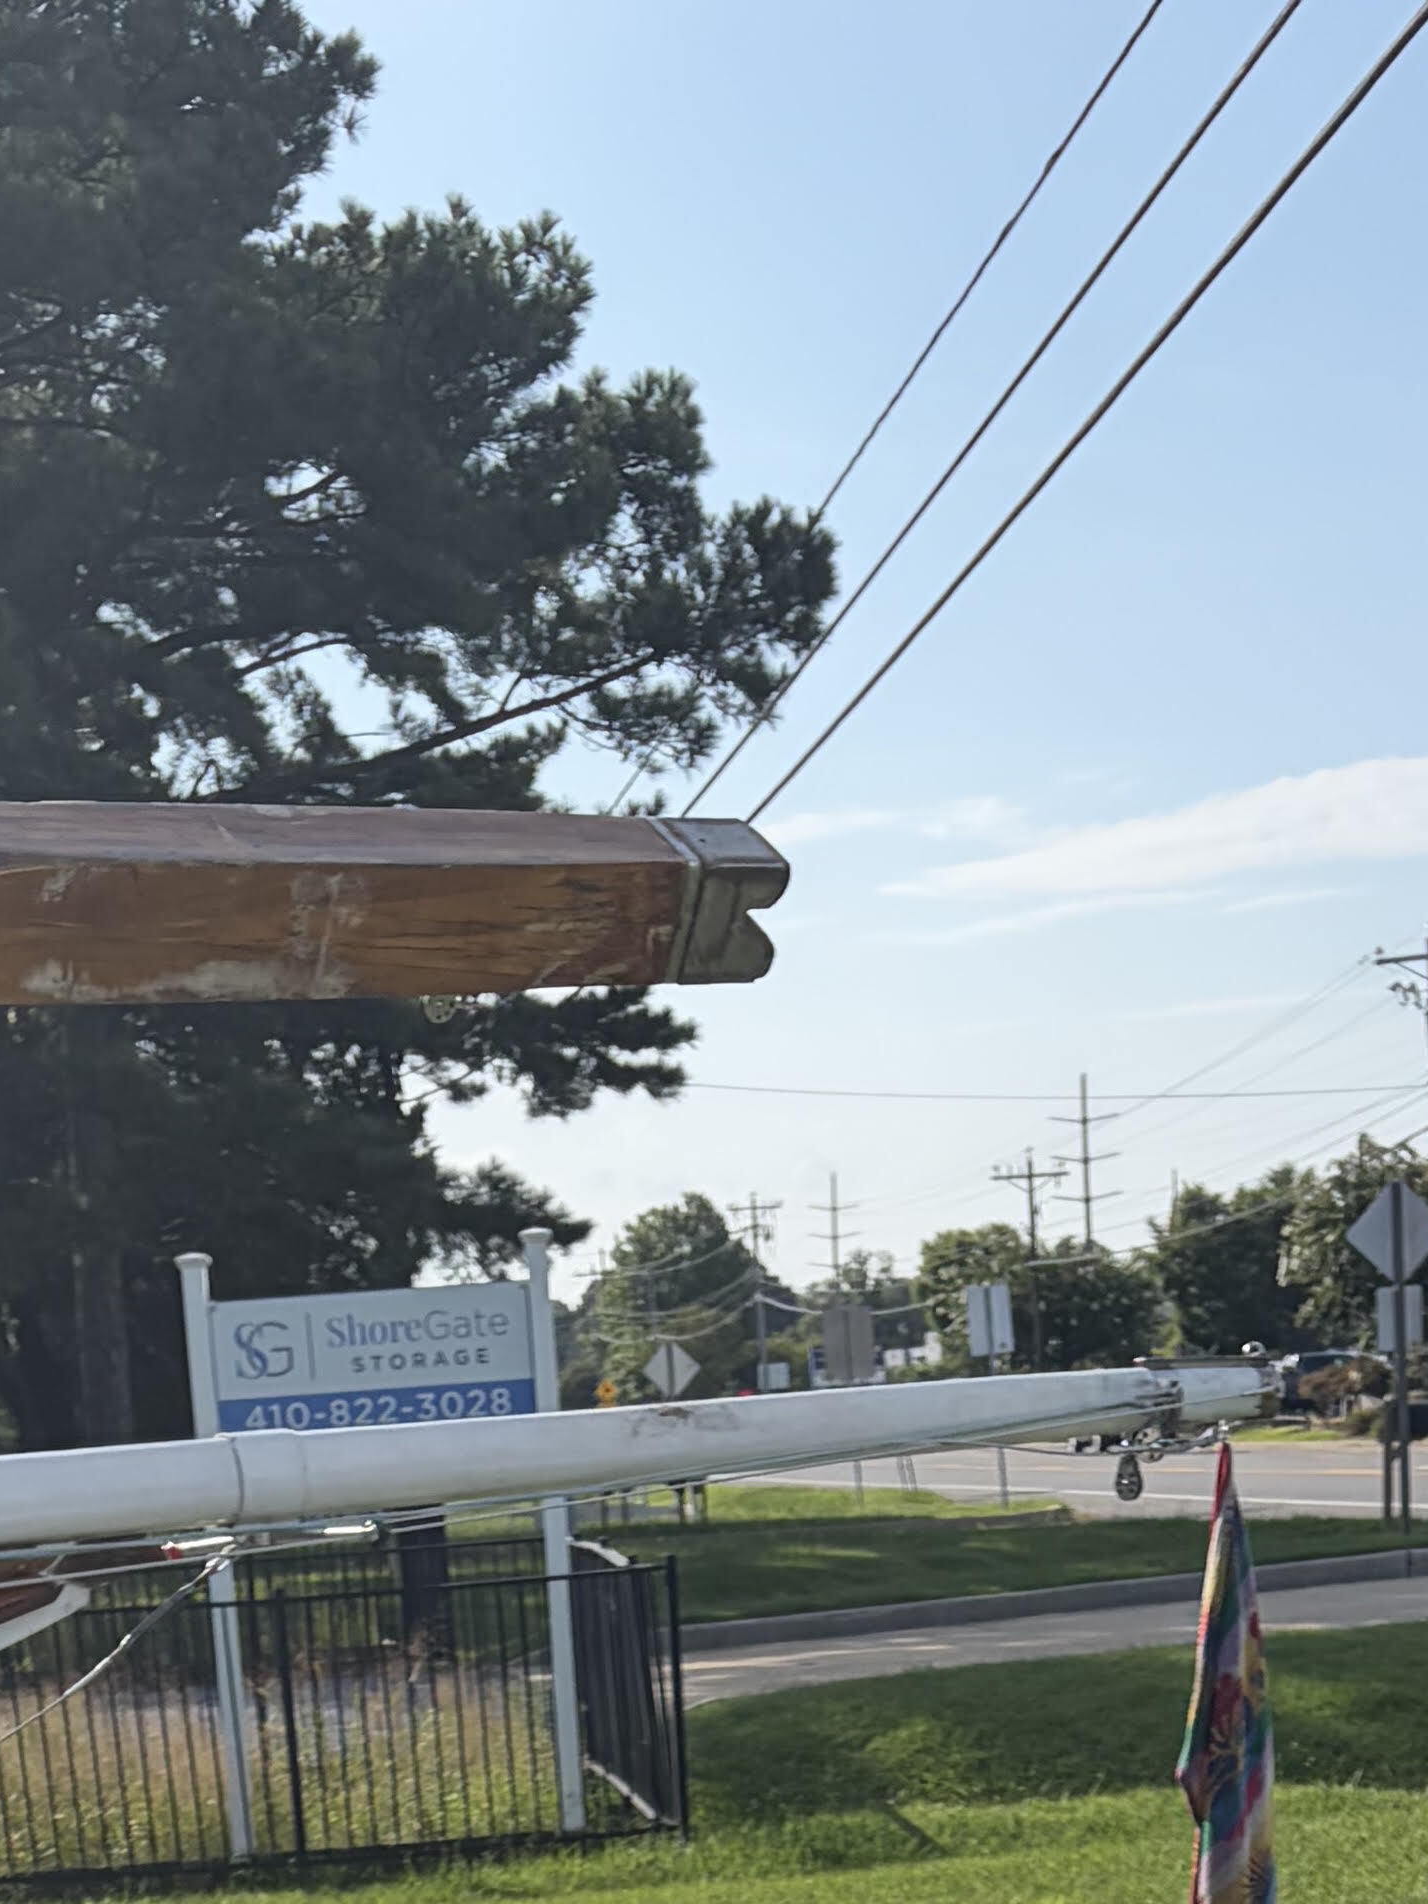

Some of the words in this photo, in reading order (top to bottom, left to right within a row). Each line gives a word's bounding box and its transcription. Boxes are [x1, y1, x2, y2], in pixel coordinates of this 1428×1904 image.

[325, 1309, 510, 1349] ShoreGate
[350, 1348, 491, 1374] STORAGE
[245, 1388, 512, 1430] 410-822-3028
